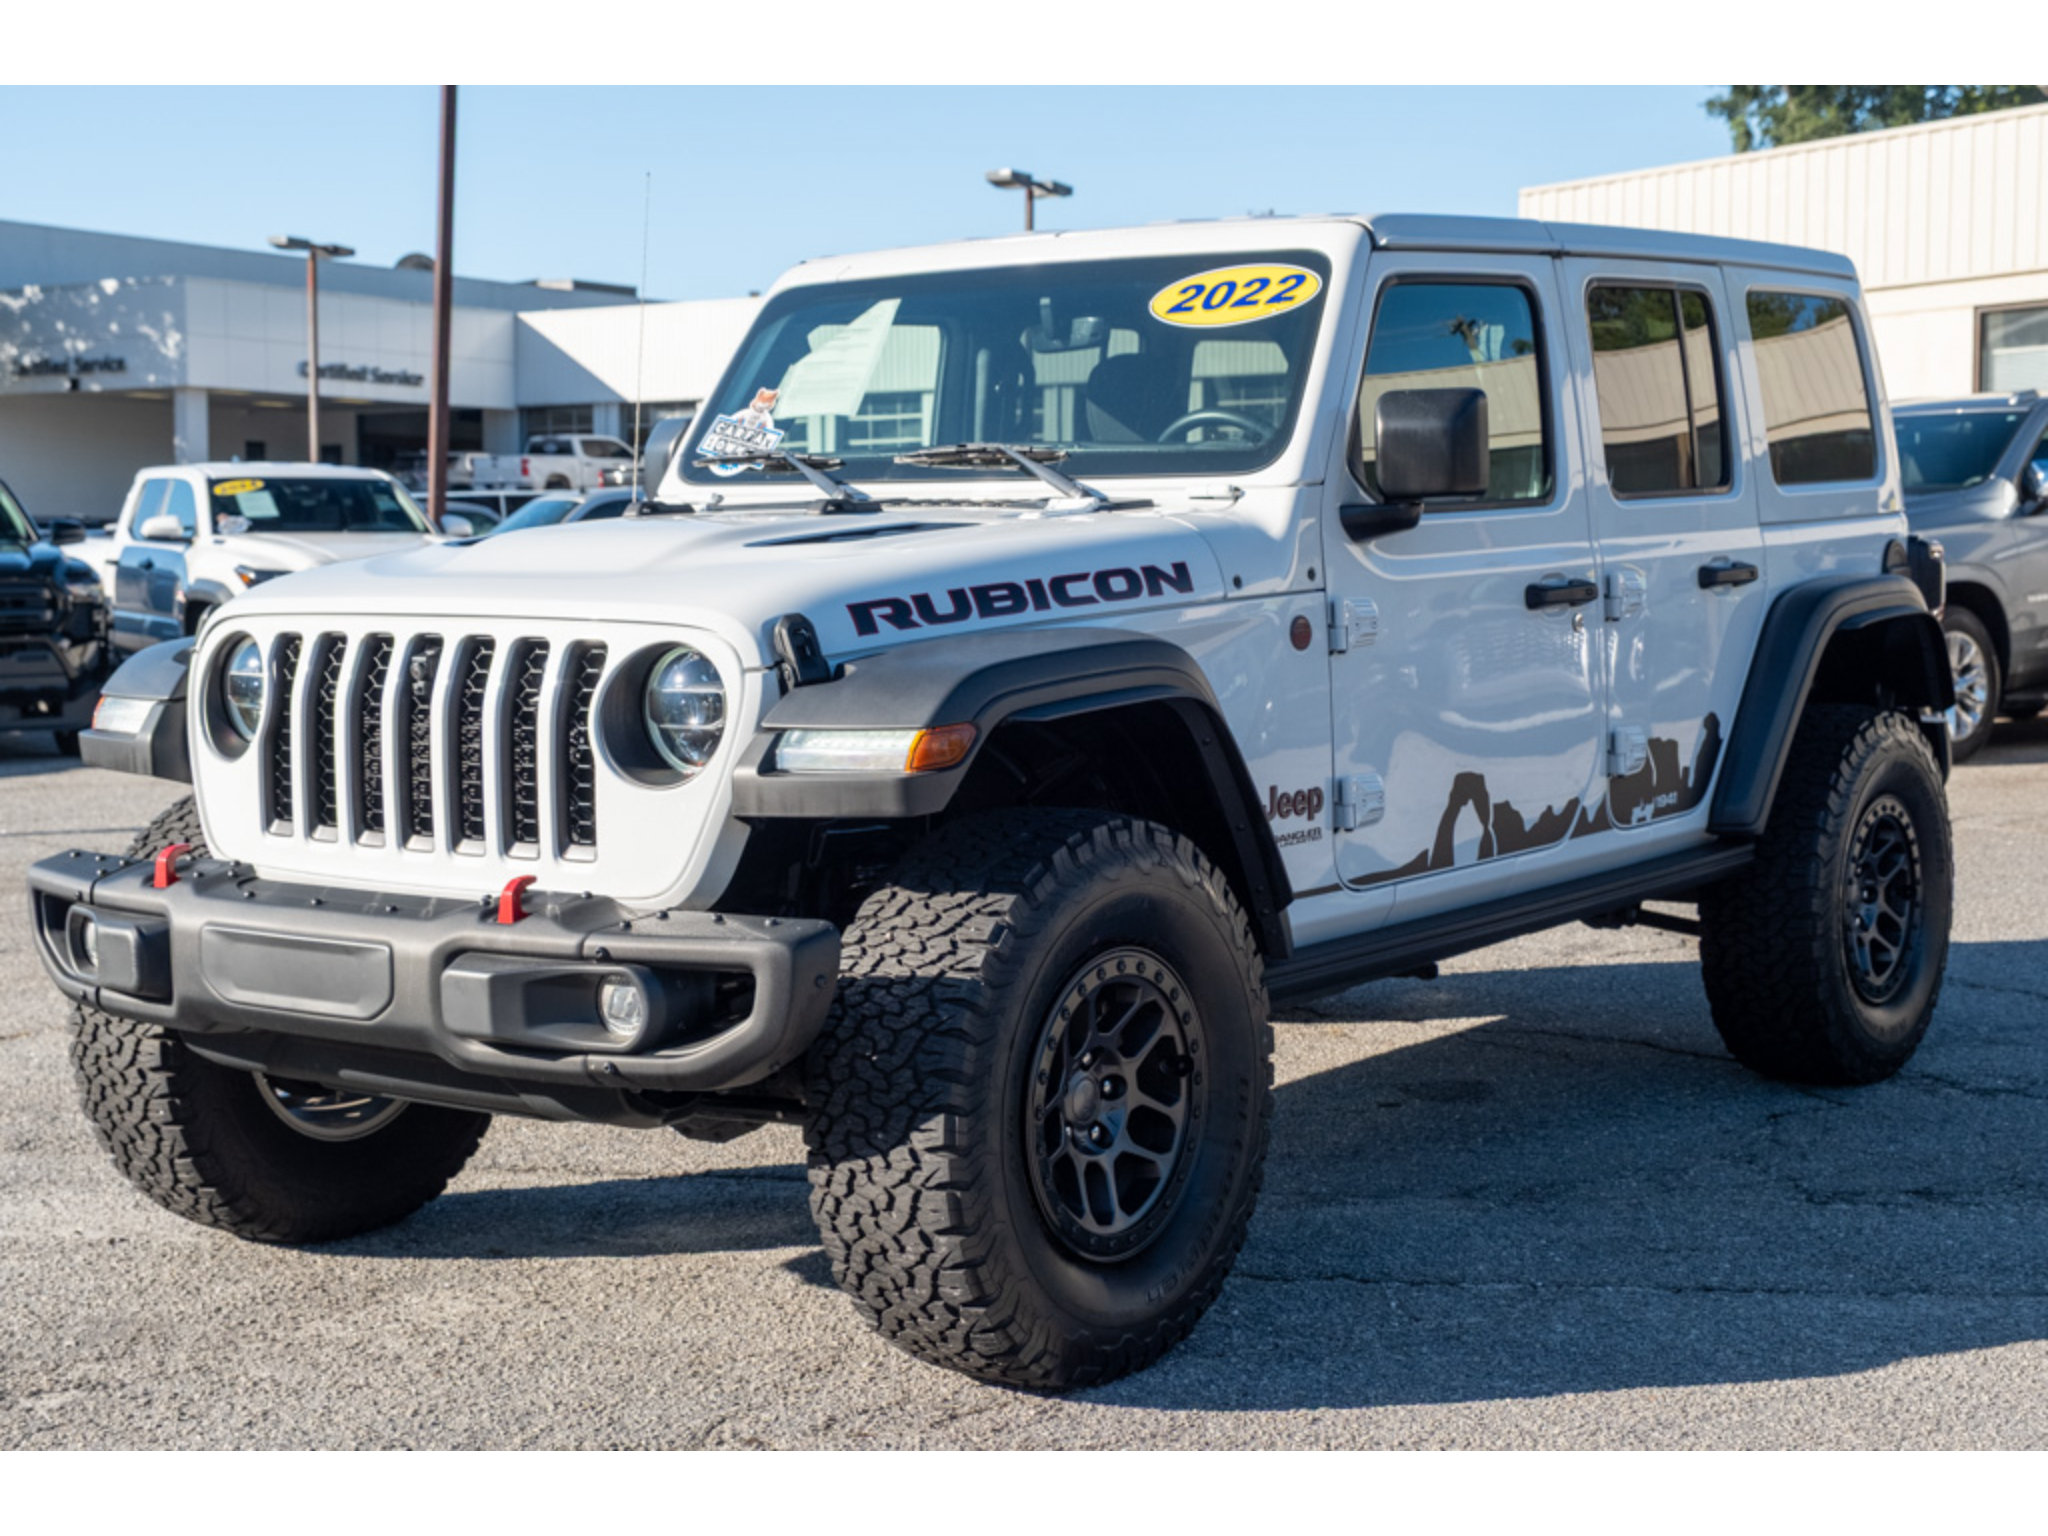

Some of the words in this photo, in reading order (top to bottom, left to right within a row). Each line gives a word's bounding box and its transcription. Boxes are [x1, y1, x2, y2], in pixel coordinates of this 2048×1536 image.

[1165, 274, 1307, 314] 2022
[846, 561, 1194, 637] RUBICON
[1263, 784, 1324, 821] Jeep
